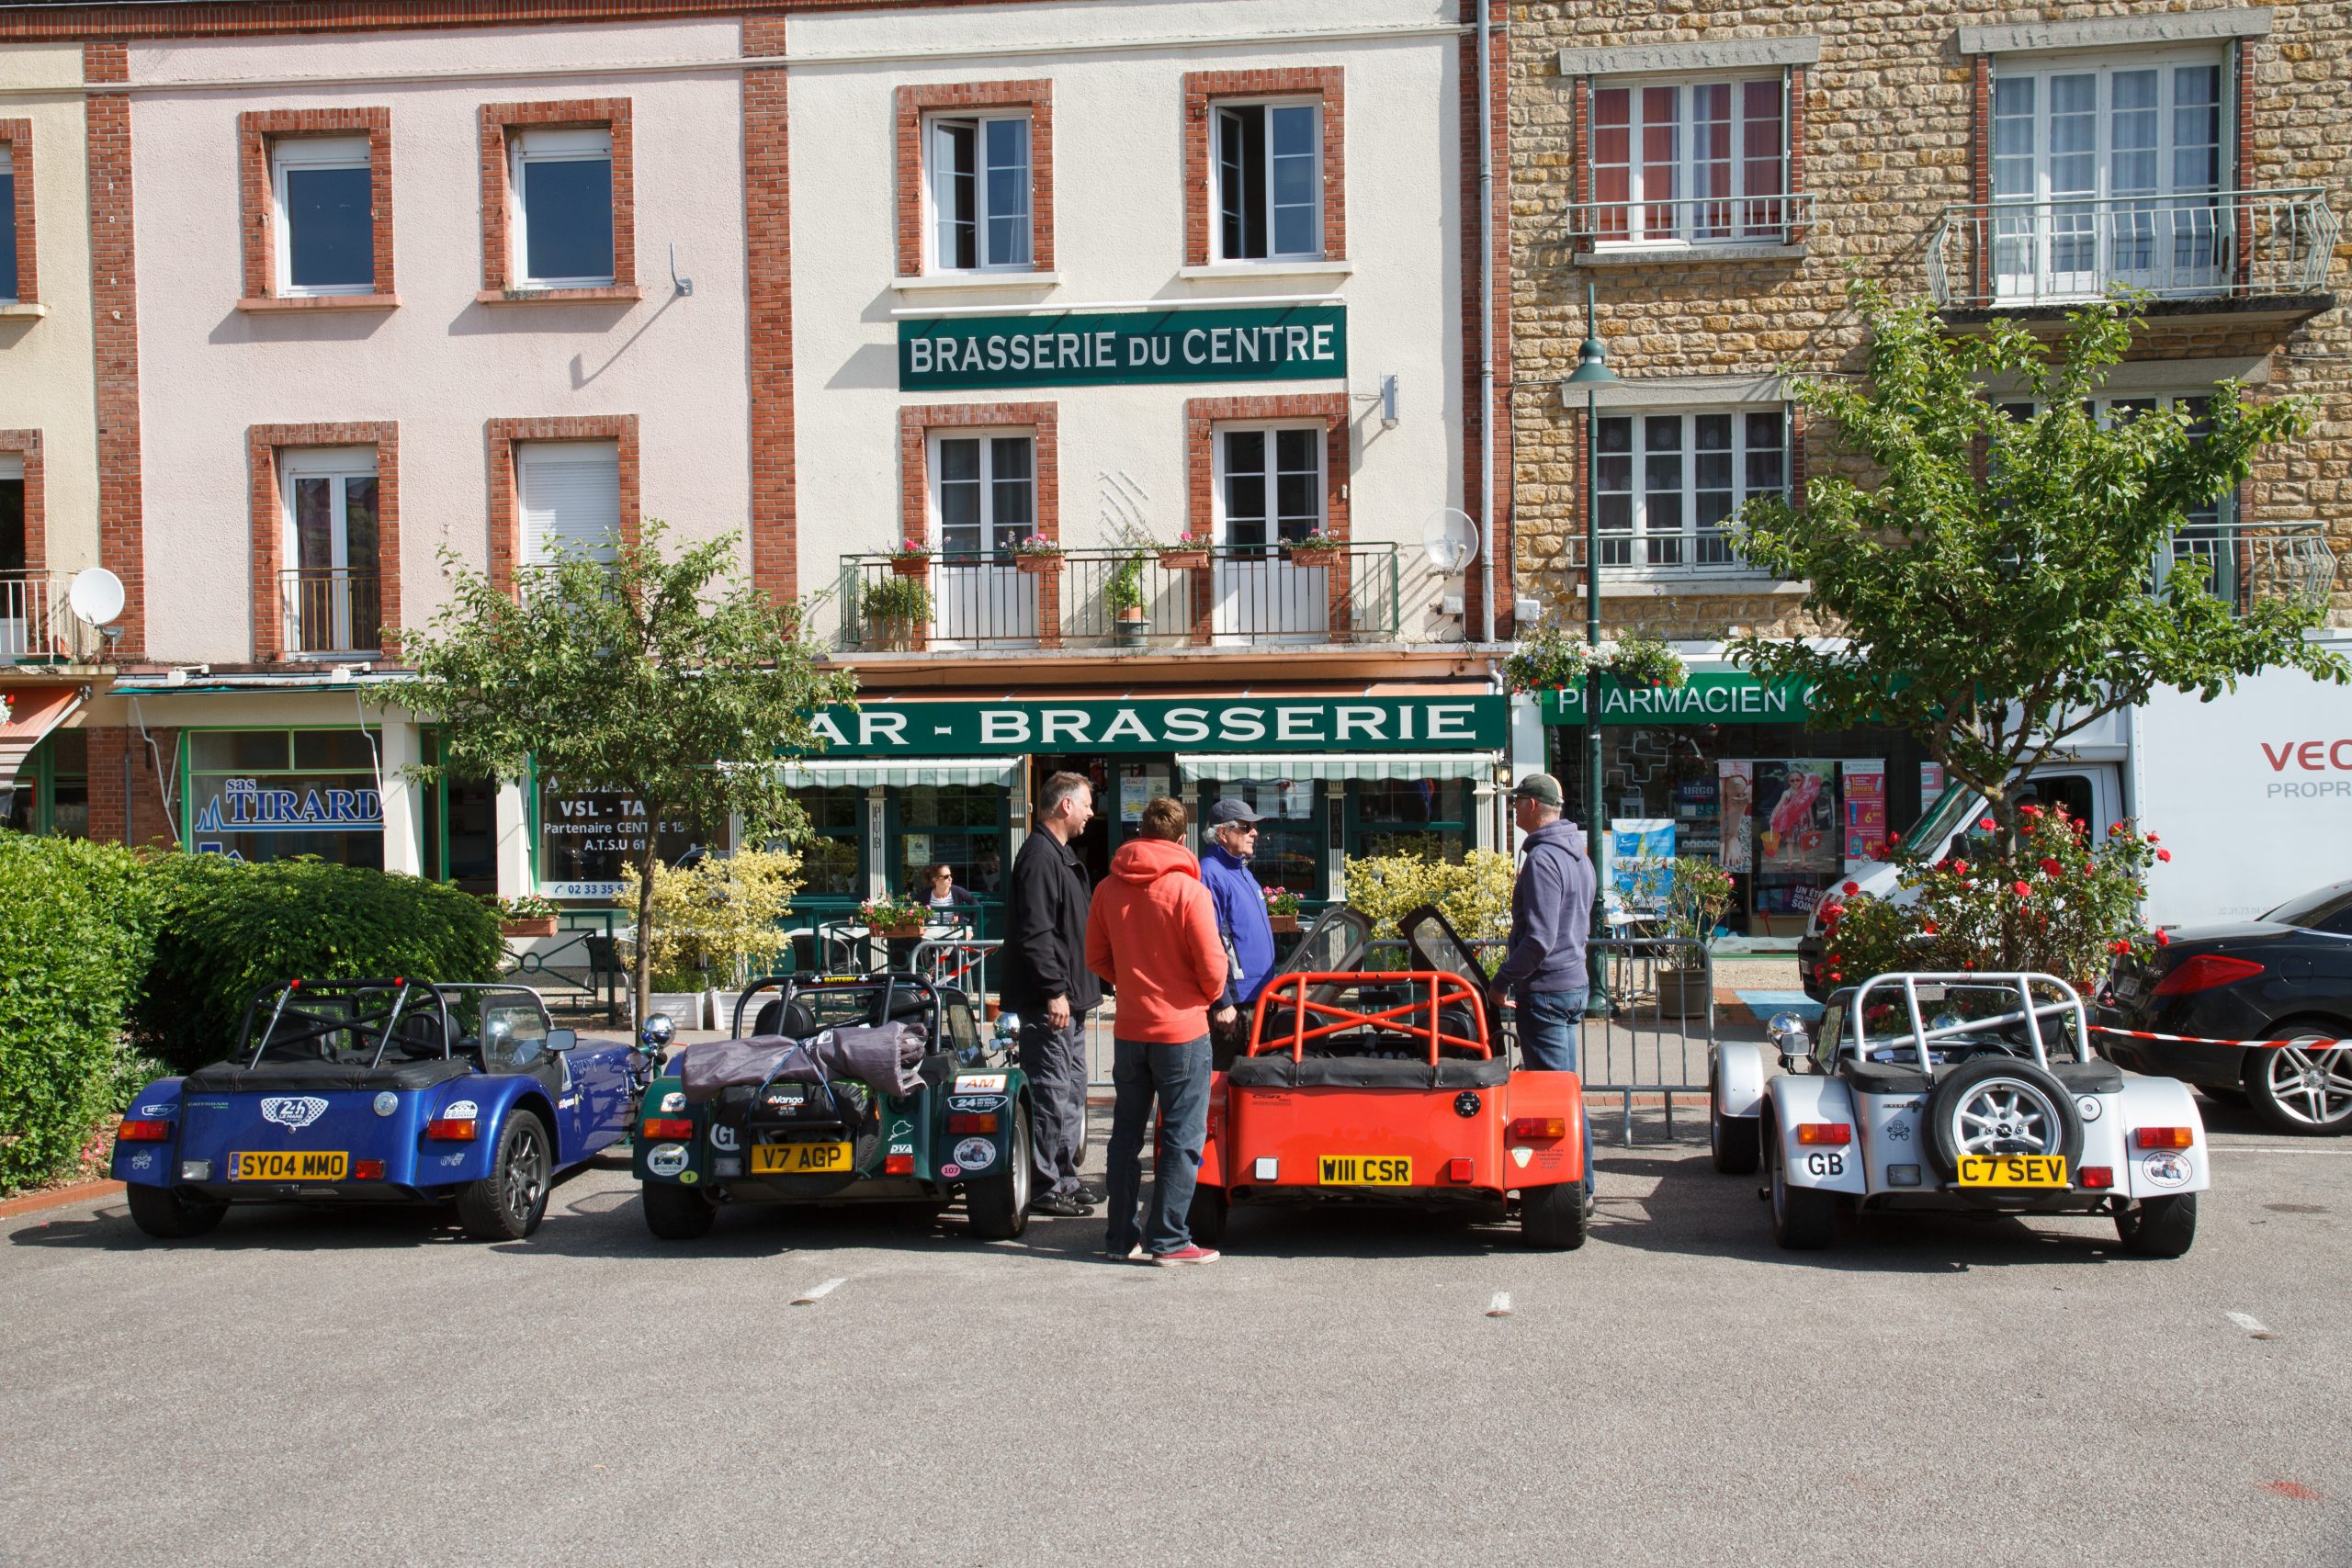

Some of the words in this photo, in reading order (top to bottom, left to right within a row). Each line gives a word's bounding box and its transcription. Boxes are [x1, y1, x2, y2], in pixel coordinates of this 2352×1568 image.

[910, 331, 1116, 373] BRASSERIE
[1129, 336, 1171, 367] DU
[1182, 324, 1334, 364] CENTRE
[811, 712, 910, 745] AR
[934, 726, 952, 736] -
[979, 704, 1476, 744] BRASSERIE
[226, 779, 256, 791] sas
[1683, 786, 1713, 795] URGO
[226, 789, 383, 823] TIRARD
[560, 801, 598, 817] VSL
[620, 801, 646, 816] TA
[544, 822, 612, 834] Partenaire
[617, 822, 666, 833] CENTE
[672, 821, 684, 832] 15
[873, 806, 881, 848] PUB
[1332, 802, 1340, 846] BAR
[584, 840, 628, 851] A.T.S.U
[633, 840, 646, 851] 61
[568, 885, 581, 894] 02
[584, 885, 597, 894] 33
[601, 885, 613, 894] 35
[1795, 885, 1807, 896] UN
[1792, 898, 1813, 911] SOIN
[824, 976, 857, 984] BATTERY
[965, 1078, 996, 1088] AM
[774, 1095, 804, 1105] Vango
[956, 1098, 977, 1107] 24
[763, 1148, 786, 1168] V7
[798, 1147, 841, 1168] AGP
[243, 1156, 296, 1176] SY04
[303, 1156, 344, 1176] MMO
[944, 1167, 959, 1175] 107
[1363, 1160, 1408, 1181] CSR
[1808, 1153, 1843, 1176] GB
[1962, 1159, 1996, 1181] C7
[2007, 1158, 2063, 1181] SEV
[685, 1173, 692, 1181] 1
